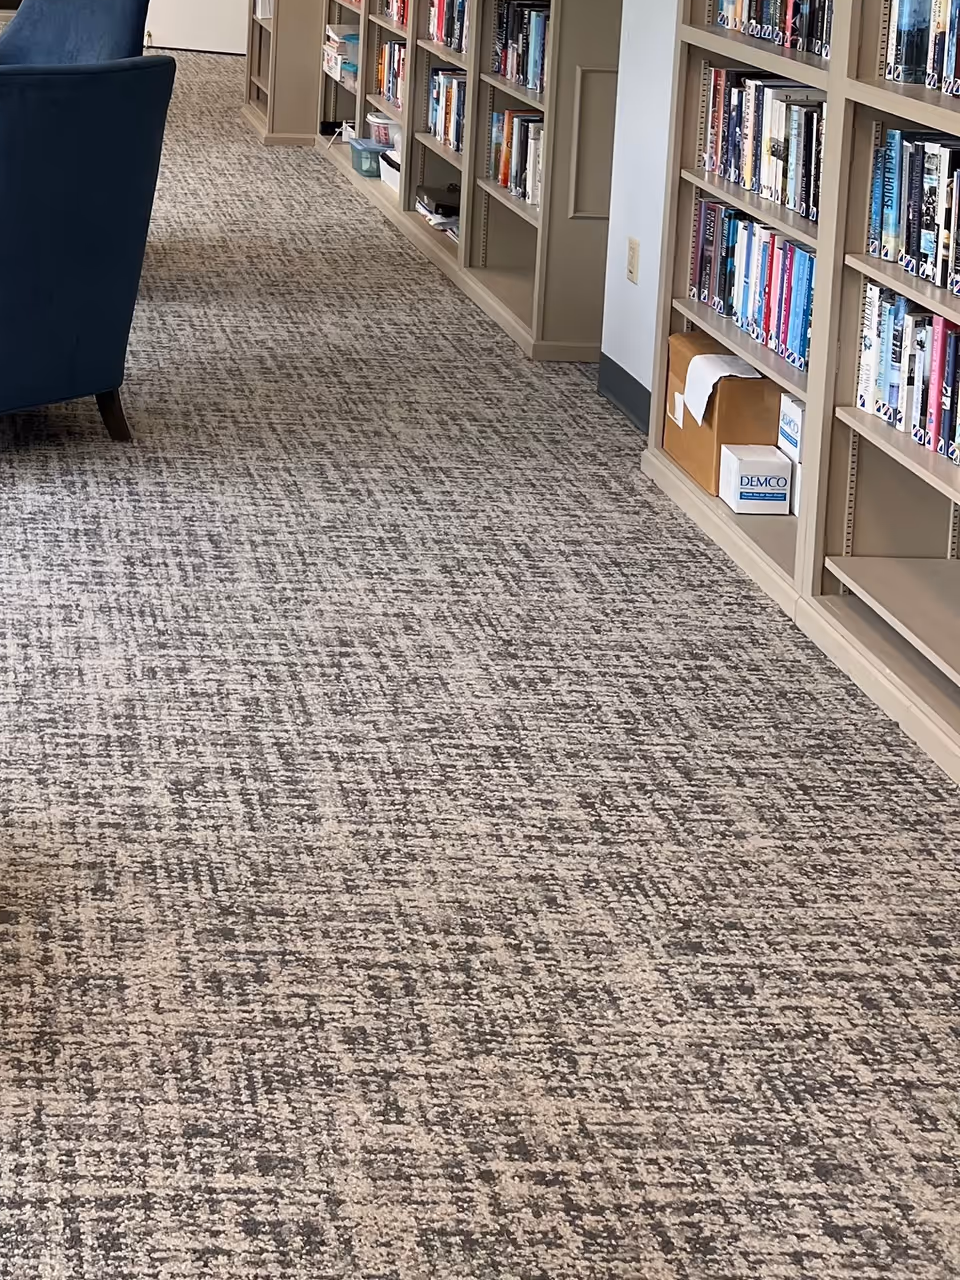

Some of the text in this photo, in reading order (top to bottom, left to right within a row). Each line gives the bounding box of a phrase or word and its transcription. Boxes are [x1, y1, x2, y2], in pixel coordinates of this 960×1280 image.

[883, 141, 895, 210] BEACH HOUSE
[878, 337, 886, 365] PLAIN
[740, 475, 788, 488] DEMCO
